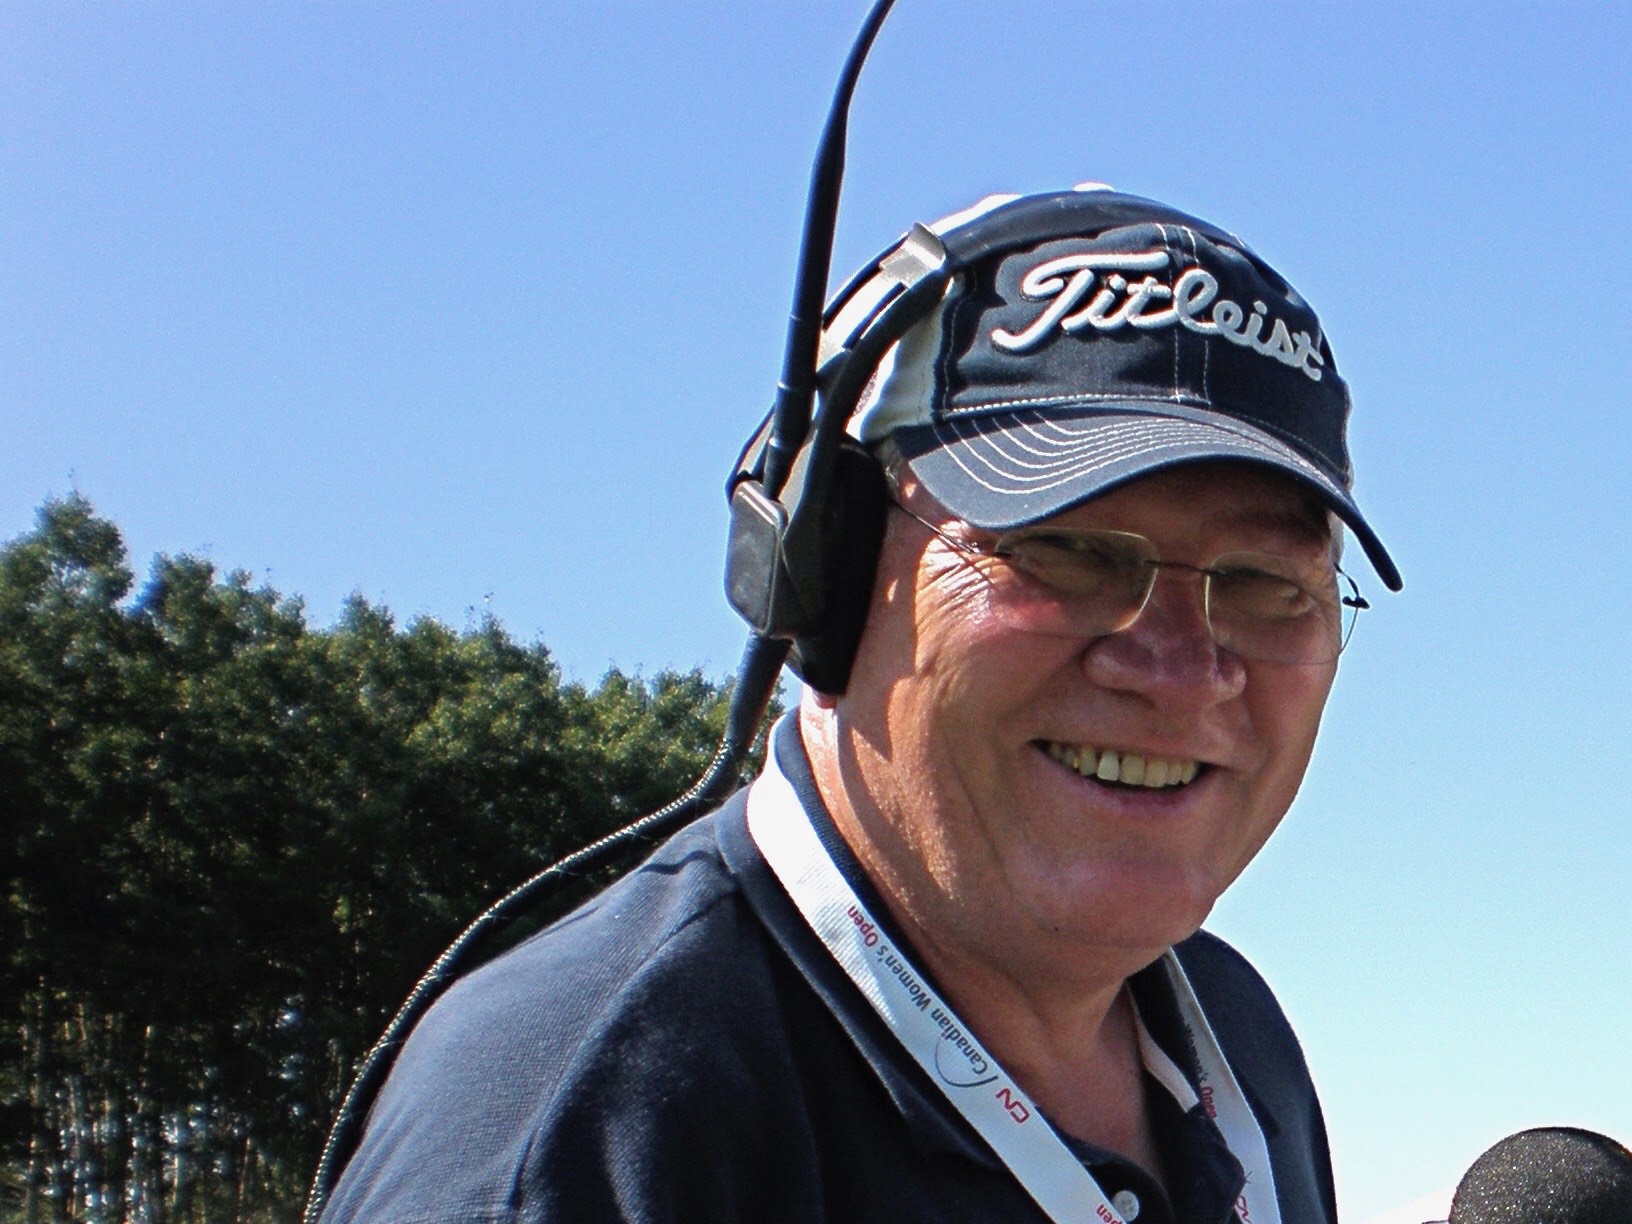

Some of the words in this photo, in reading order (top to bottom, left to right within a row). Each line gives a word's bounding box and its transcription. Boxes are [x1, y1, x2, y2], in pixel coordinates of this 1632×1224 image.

[991, 250, 1324, 381] Titleist
[847, 906, 879, 948] Open
[876, 944, 932, 1012] Women's
[931, 1008, 989, 1076] Canadian
[995, 1088, 1030, 1124] CN
